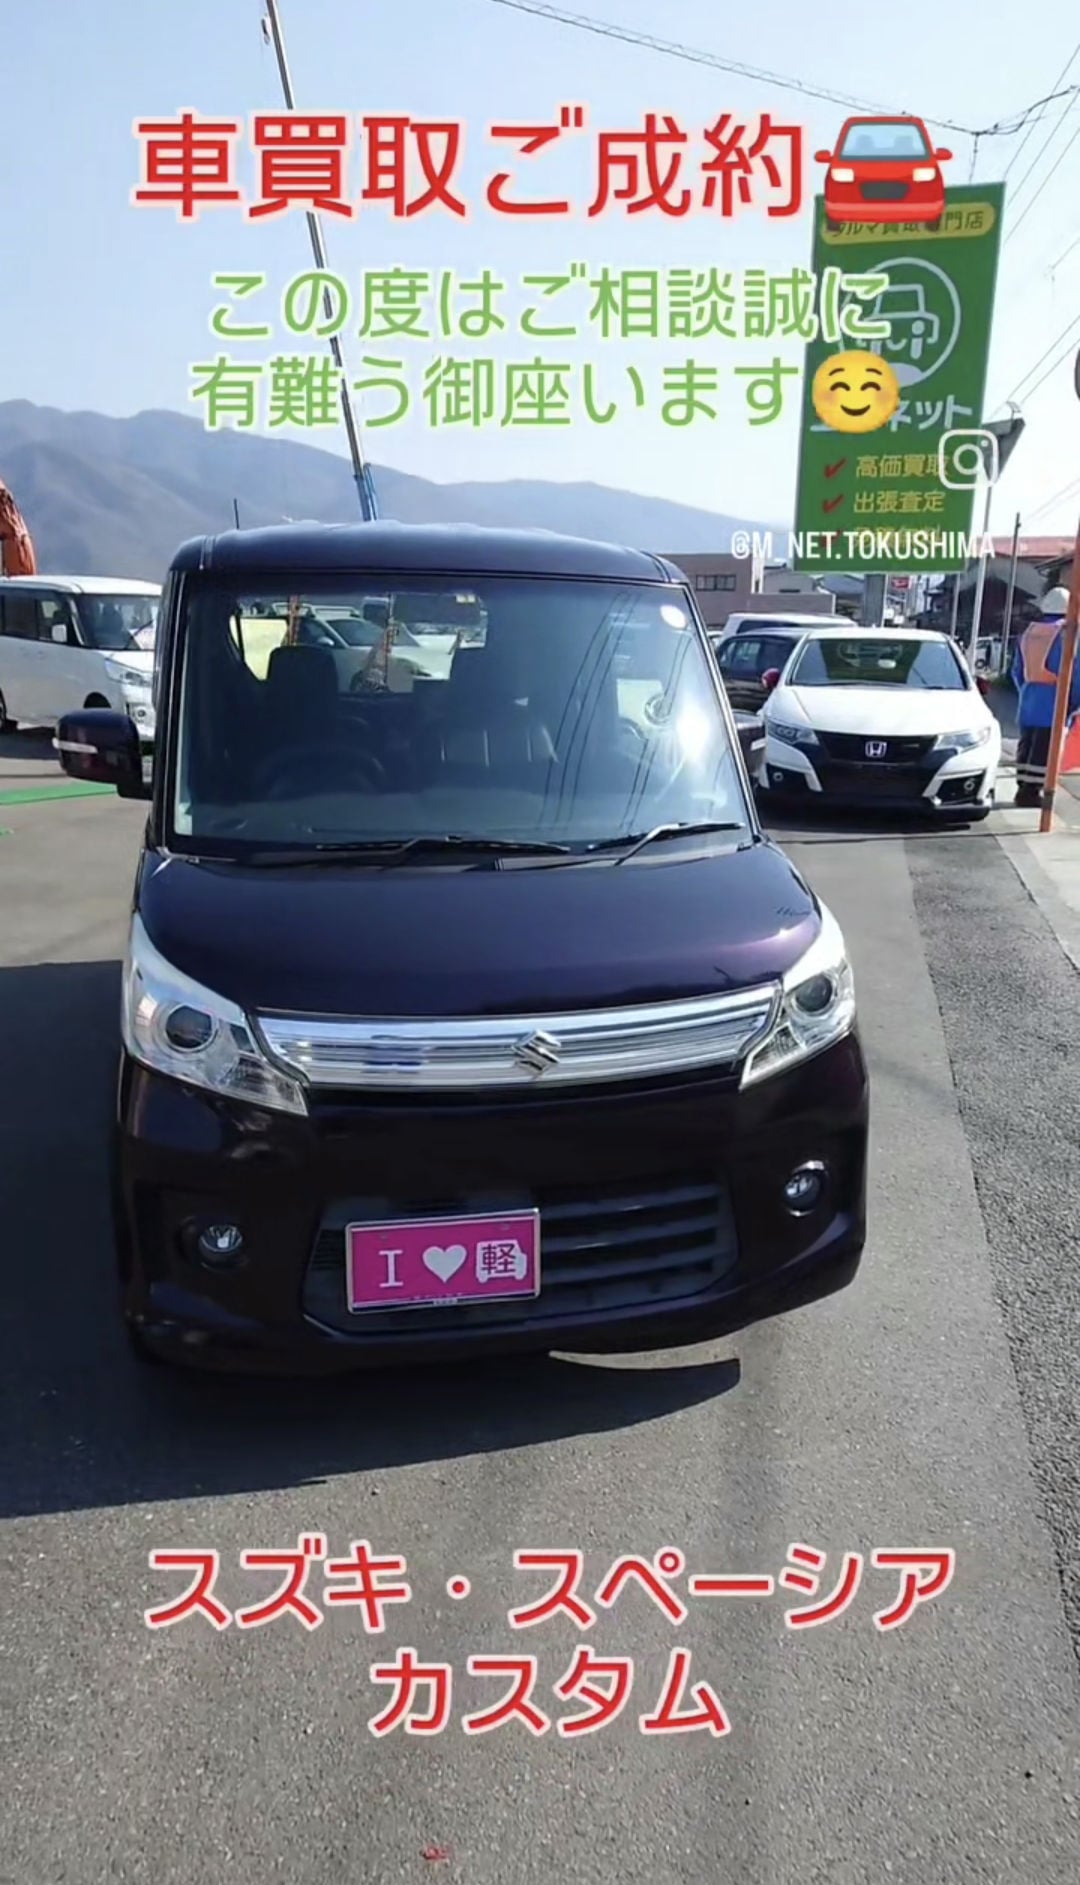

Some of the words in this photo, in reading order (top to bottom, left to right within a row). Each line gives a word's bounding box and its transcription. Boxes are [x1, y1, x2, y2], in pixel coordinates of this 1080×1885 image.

[853, 490, 946, 513] 出張査定
[379, 1249, 404, 1288] I
[480, 1243, 517, 1275] 軽
